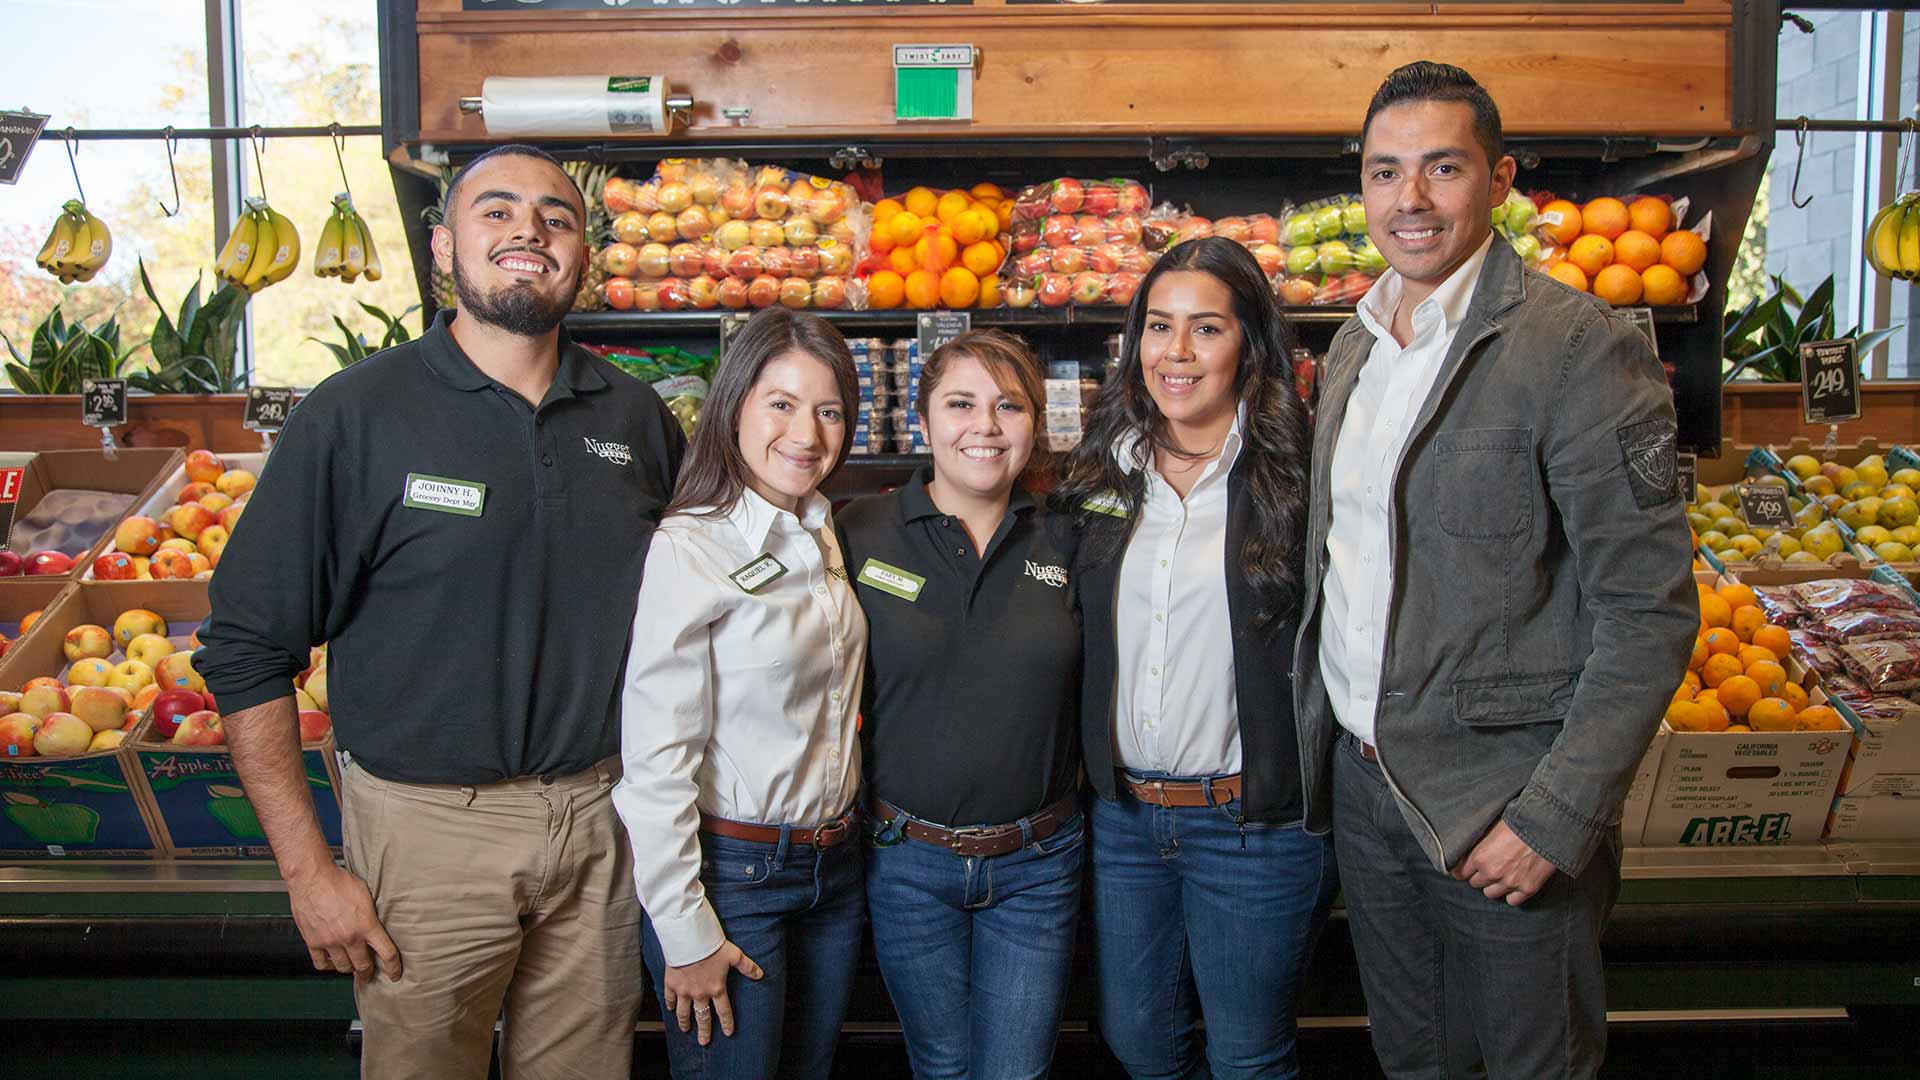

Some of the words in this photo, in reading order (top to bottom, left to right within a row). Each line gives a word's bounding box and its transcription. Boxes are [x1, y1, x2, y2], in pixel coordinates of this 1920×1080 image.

[1813, 368, 1845, 400] 249
[583, 437, 630, 454] Nugget
[418, 482, 460, 496] JOHNNY
[462, 488, 472, 498] H.
[413, 492, 442, 502] Grocery
[443, 497, 460, 505] Dept
[463, 500, 476, 508] Mgr
[1756, 501, 1782, 520] 499
[740, 564, 766, 582] RAQUEL
[147, 755, 211, 779] Apple
[214, 757, 233, 771] Tr
